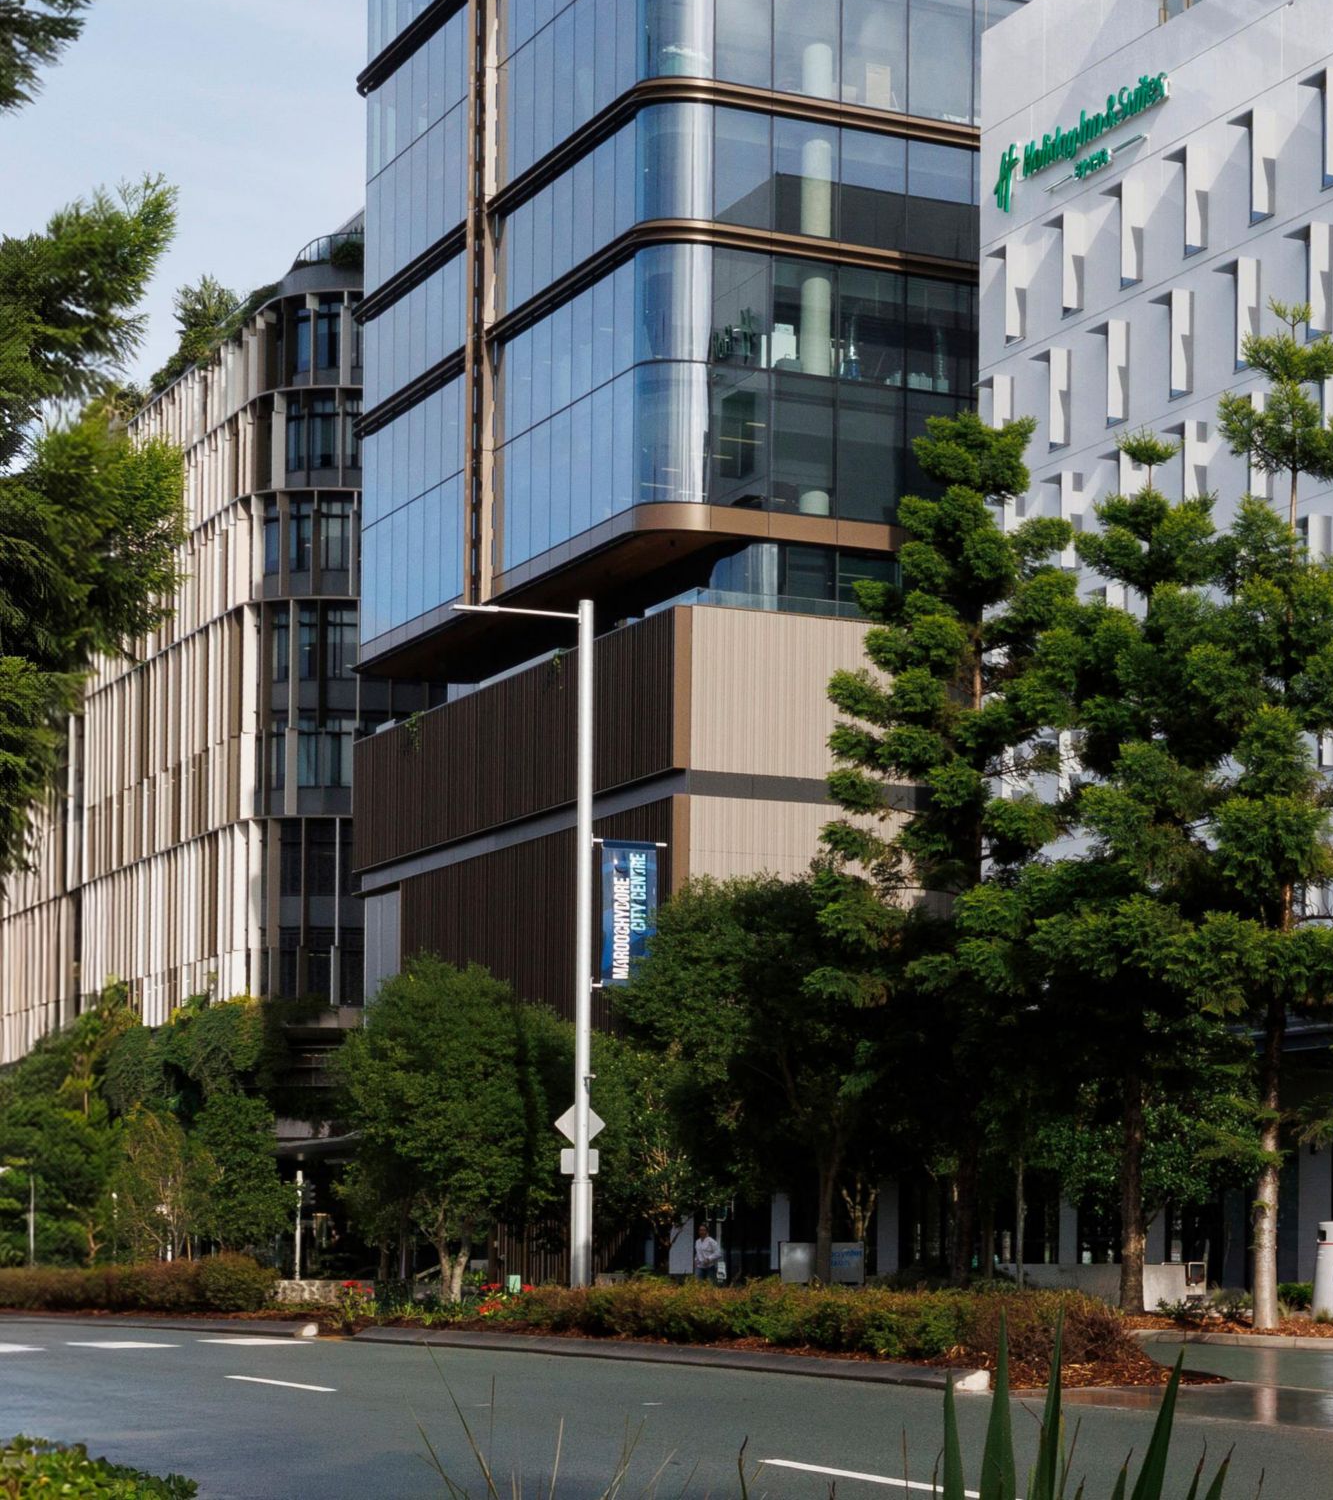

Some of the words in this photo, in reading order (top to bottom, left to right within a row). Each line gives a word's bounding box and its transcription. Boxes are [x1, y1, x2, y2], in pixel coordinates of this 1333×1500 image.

[630, 853, 646, 901] CENTRE
[612, 877, 630, 980] MAROOCHYDORE
[630, 901, 646, 931] CITY
